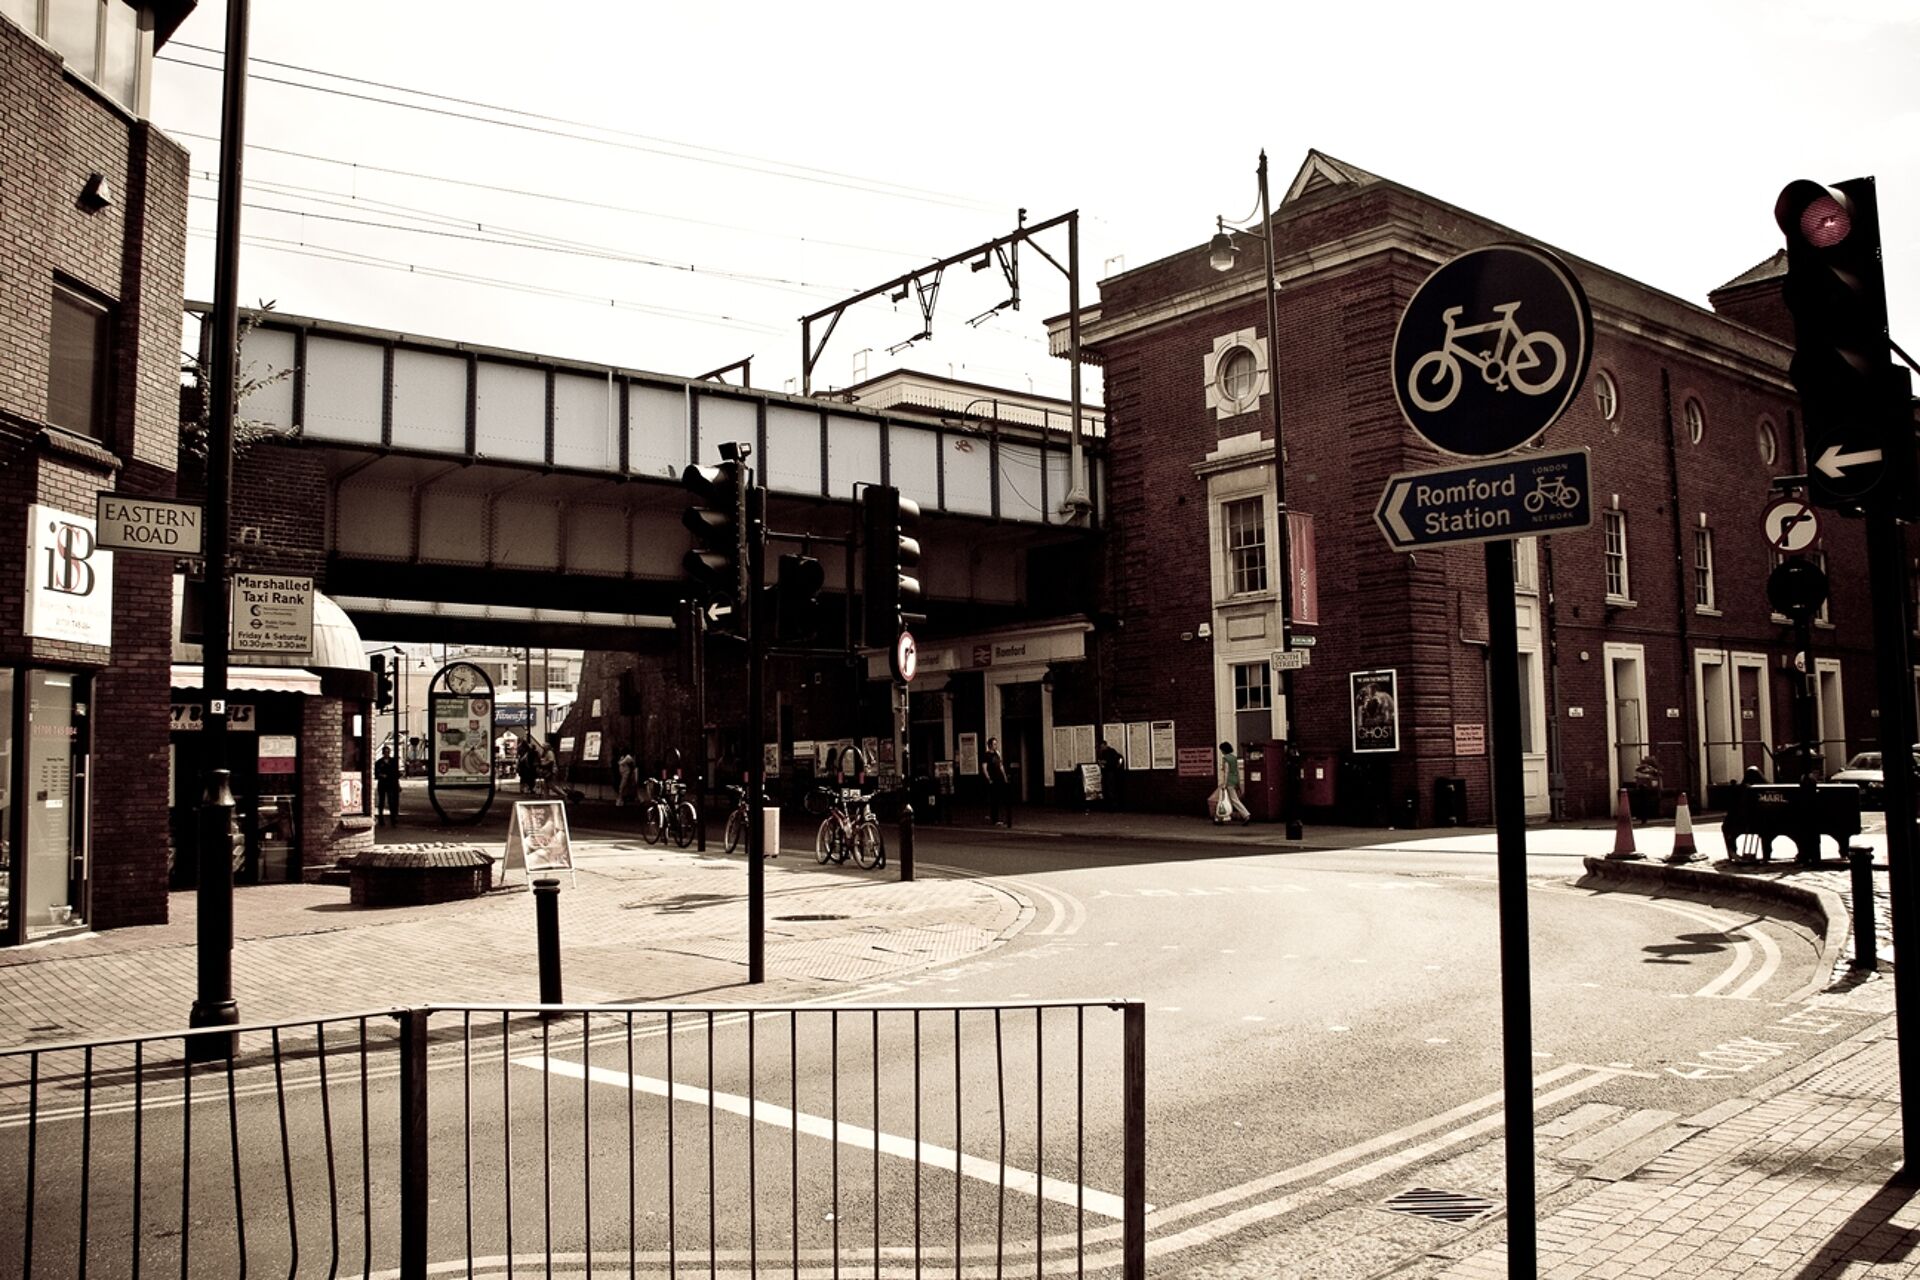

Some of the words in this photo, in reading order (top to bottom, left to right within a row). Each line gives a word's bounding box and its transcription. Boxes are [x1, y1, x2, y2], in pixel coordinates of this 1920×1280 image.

[1532, 463, 1568, 475] LONDON
[1416, 473, 1517, 507] Romford
[105, 503, 196, 527] EASTERN
[1424, 507, 1511, 535] Station
[1531, 512, 1574, 523] NETWORK
[123, 524, 179, 545] ROAD
[238, 577, 310, 591] Marshalled
[243, 591, 269, 602] Taxi
[272, 592, 305, 605] Rank
[237, 631, 262, 640] Friday
[264, 632, 271, 640] &
[273, 632, 307, 642] Saturday
[995, 643, 1026, 657] Romford
[1274, 653, 1299, 661] SOUTH
[1274, 660, 1300, 668] STREET
[214, 702, 221, 711] 9
[1357, 726, 1392, 739] GHOST
